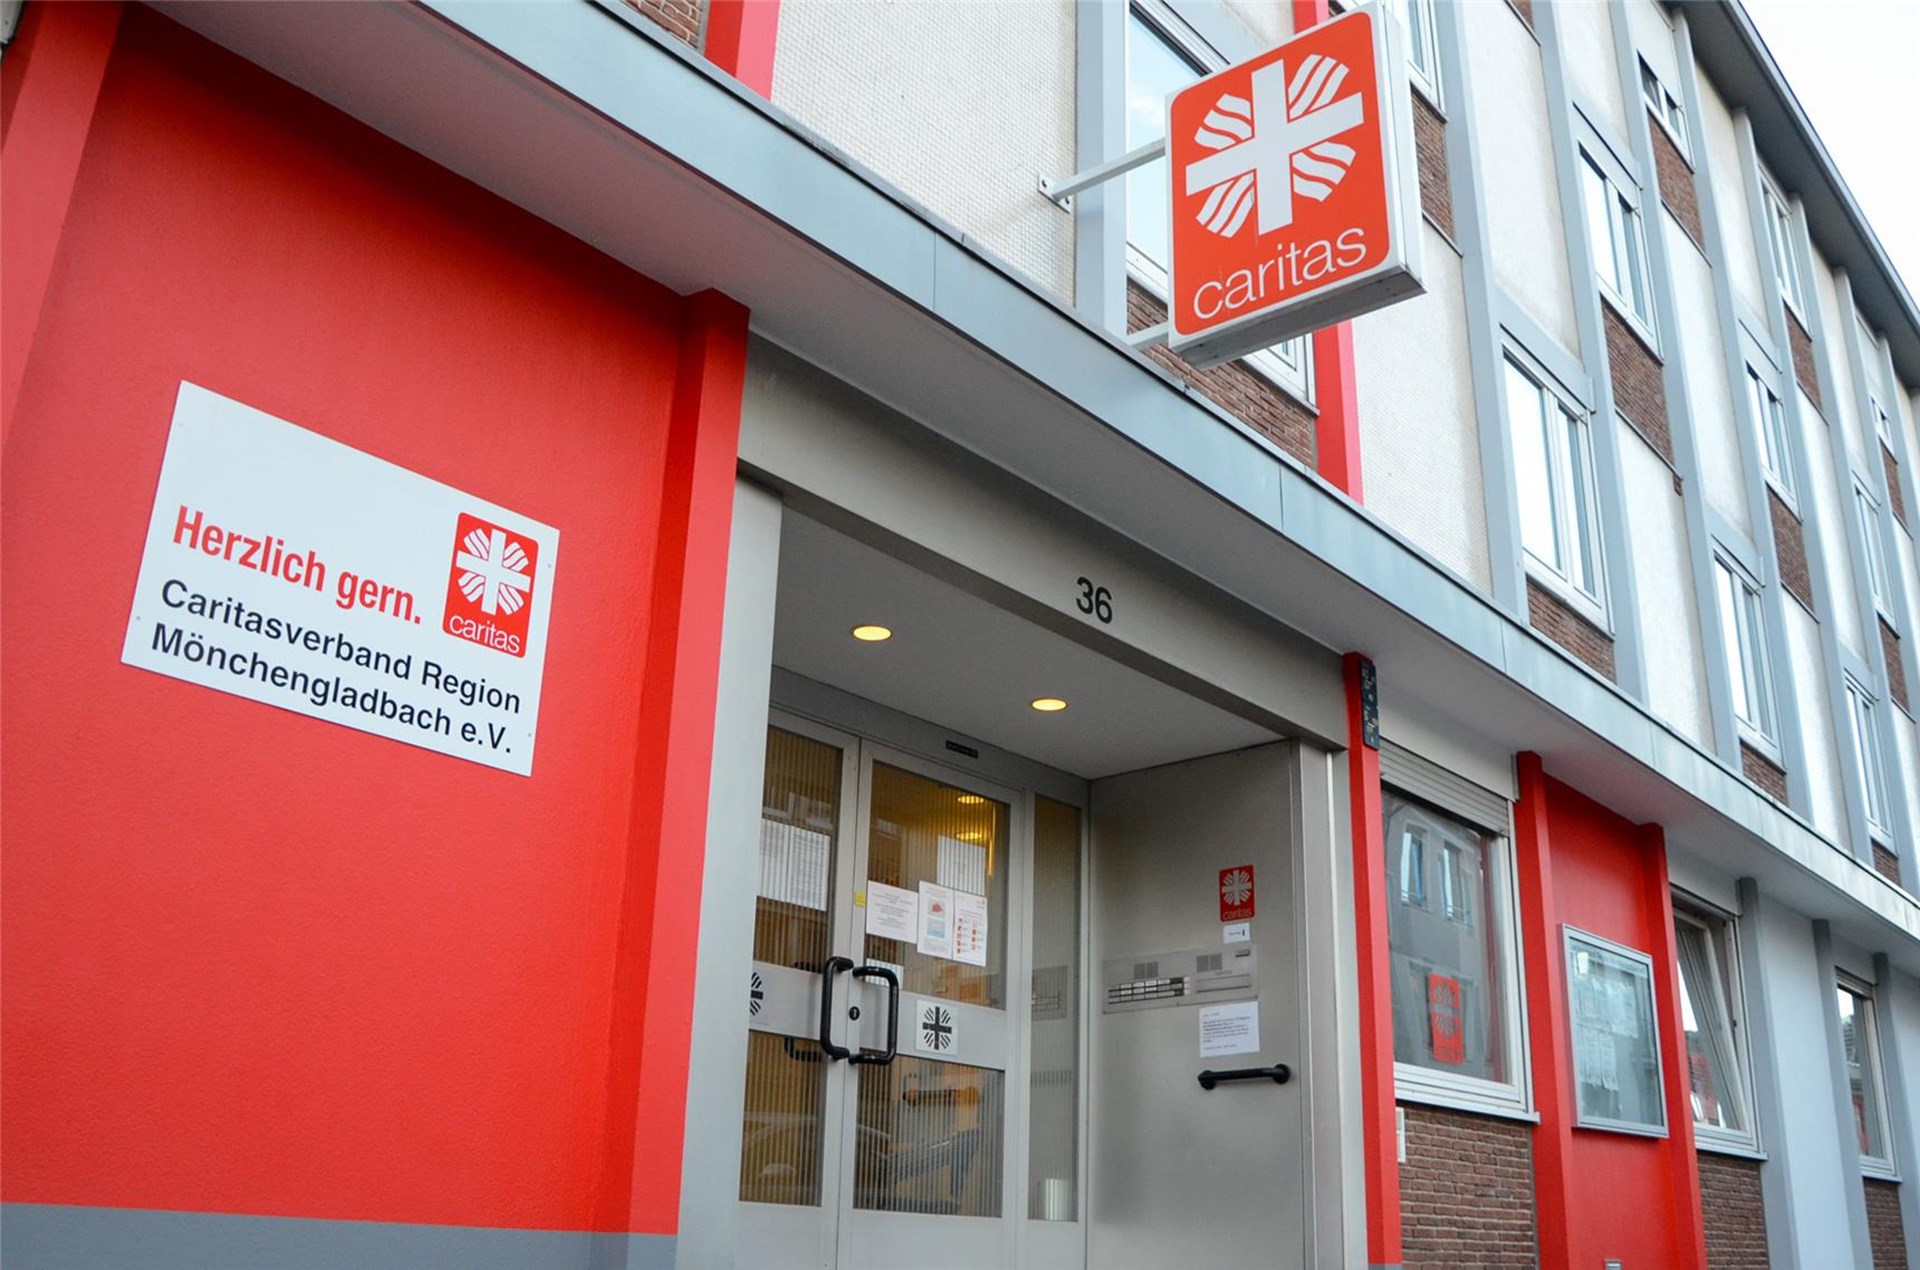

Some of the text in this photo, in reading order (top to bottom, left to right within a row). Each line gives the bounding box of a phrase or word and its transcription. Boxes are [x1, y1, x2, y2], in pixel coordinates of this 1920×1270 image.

[1193, 227, 1367, 319] caritas
[173, 505, 422, 624] Herzlich gern.
[1076, 576, 1112, 624] 36
[161, 579, 521, 714] Caritasverband Region
[449, 614, 521, 654] caritas
[151, 622, 512, 753] Mönchengladbach e.V.
[1222, 908, 1252, 920] caritas
